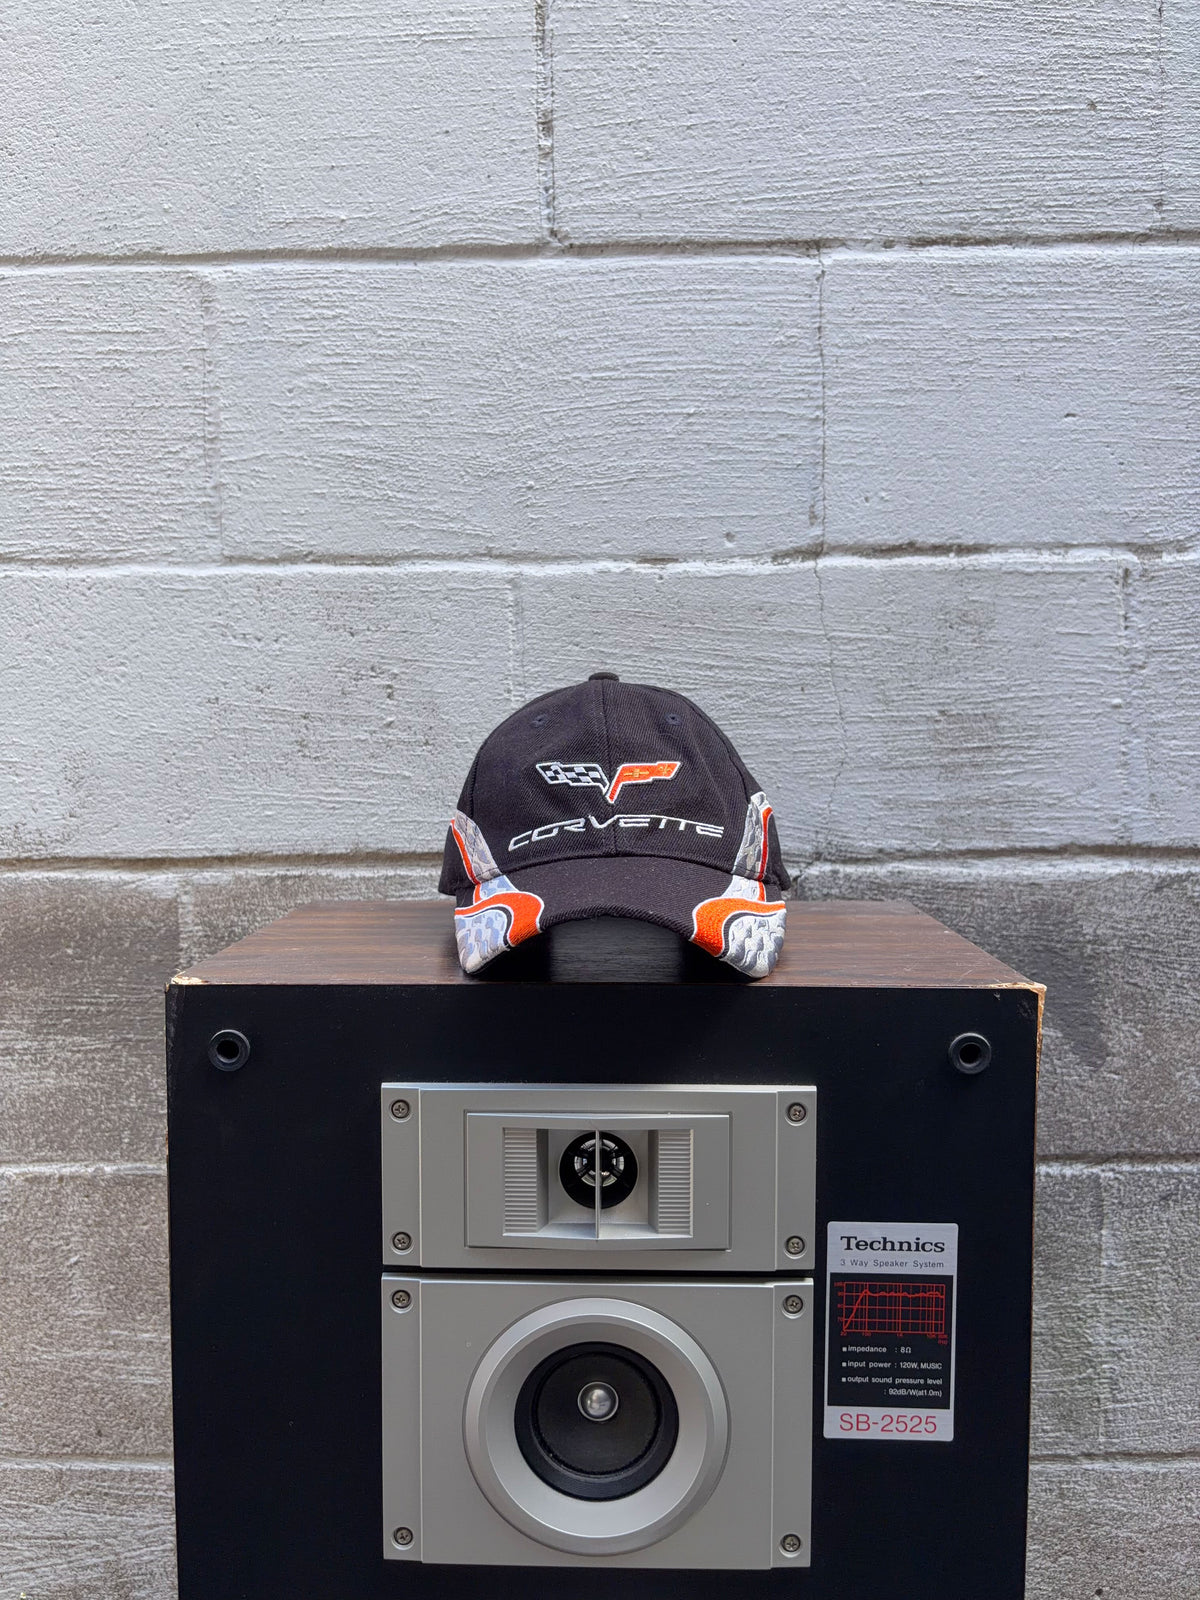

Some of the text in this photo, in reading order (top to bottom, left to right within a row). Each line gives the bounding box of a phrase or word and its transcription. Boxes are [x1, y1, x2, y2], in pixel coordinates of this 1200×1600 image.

[508, 814, 725, 851] CORVETTE
[840, 1235, 945, 1253] Technics
[840, 1259, 944, 1269] 3 Way Speaker System
[920, 1362, 942, 1370] MUSIC
[847, 1376, 869, 1384] output
[839, 1413, 937, 1434] SB-2525
